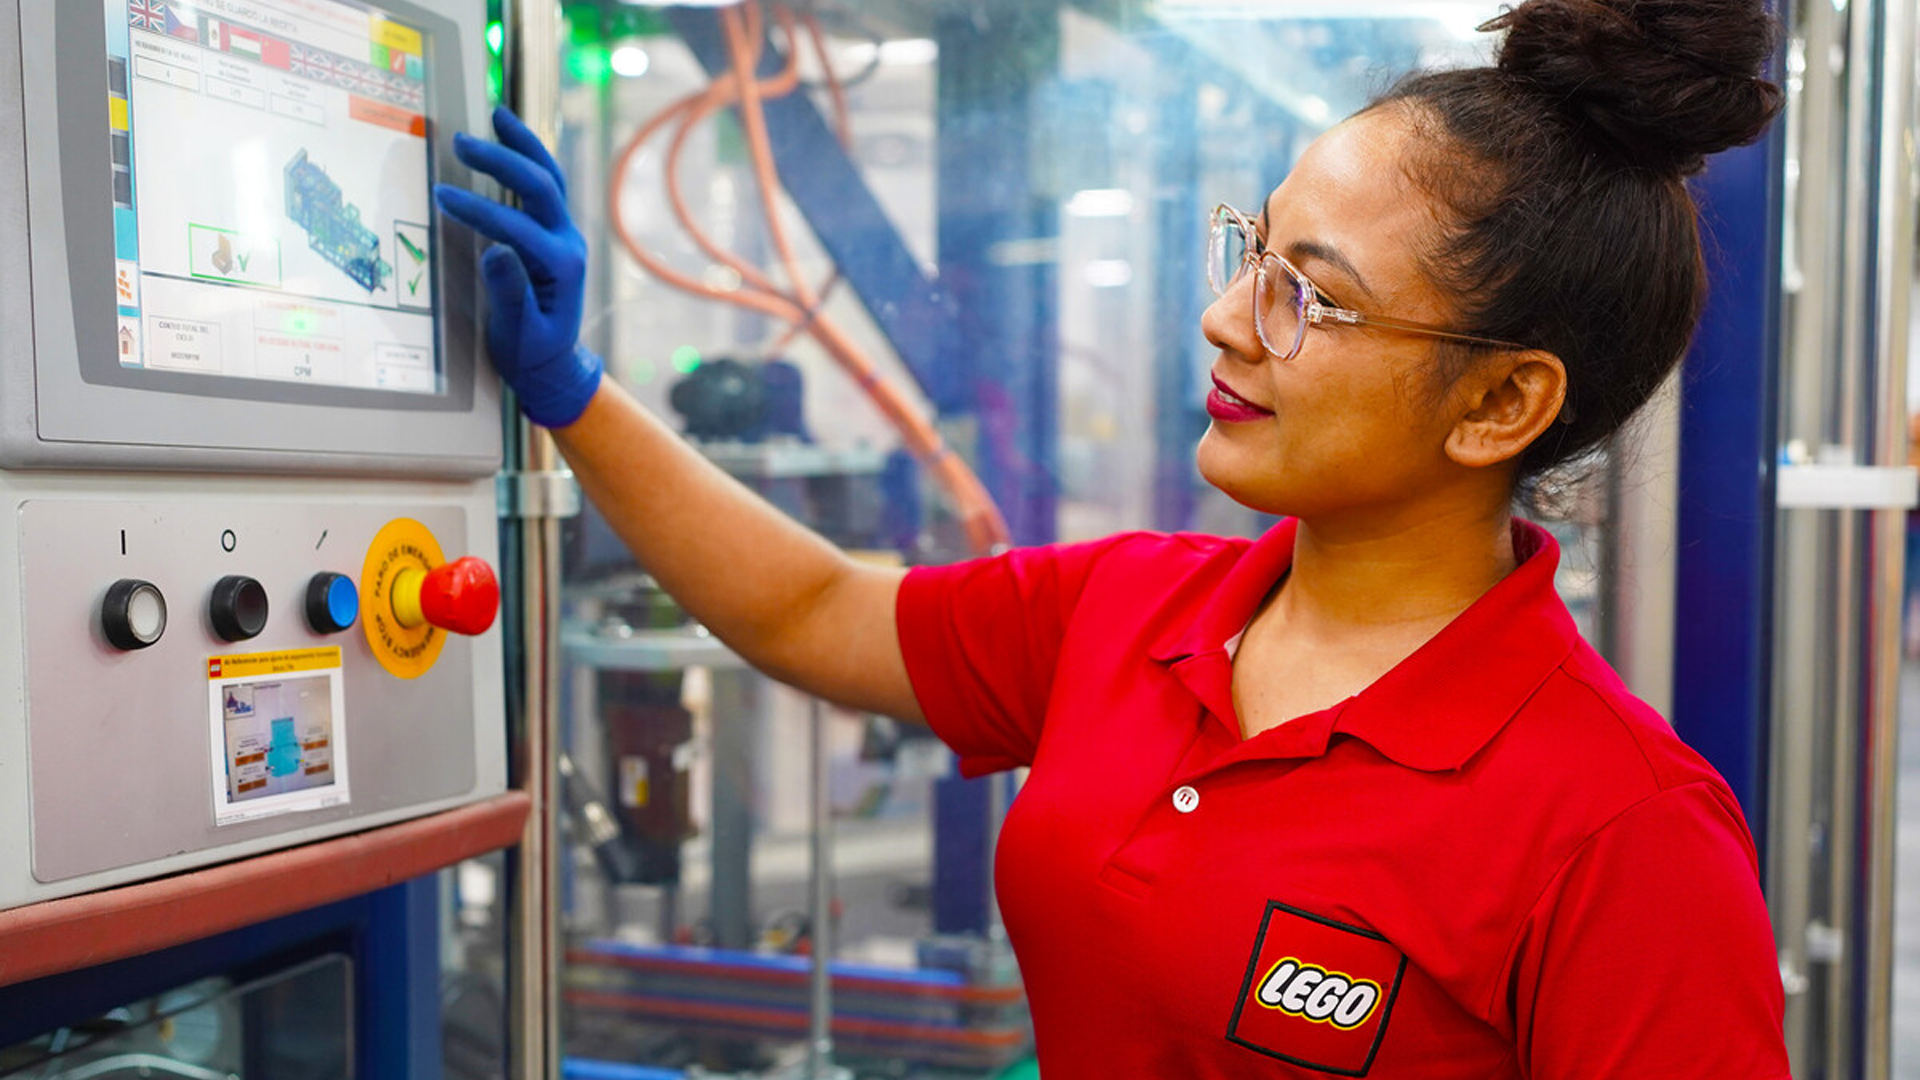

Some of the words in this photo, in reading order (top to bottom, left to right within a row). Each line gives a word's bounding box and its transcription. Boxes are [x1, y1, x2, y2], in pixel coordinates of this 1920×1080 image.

[294, 365, 312, 377] CPM
[374, 560, 389, 598] PARO
[387, 547, 399, 562] DE
[375, 613, 393, 648] STOP
[1257, 959, 1380, 1028] LEGO
